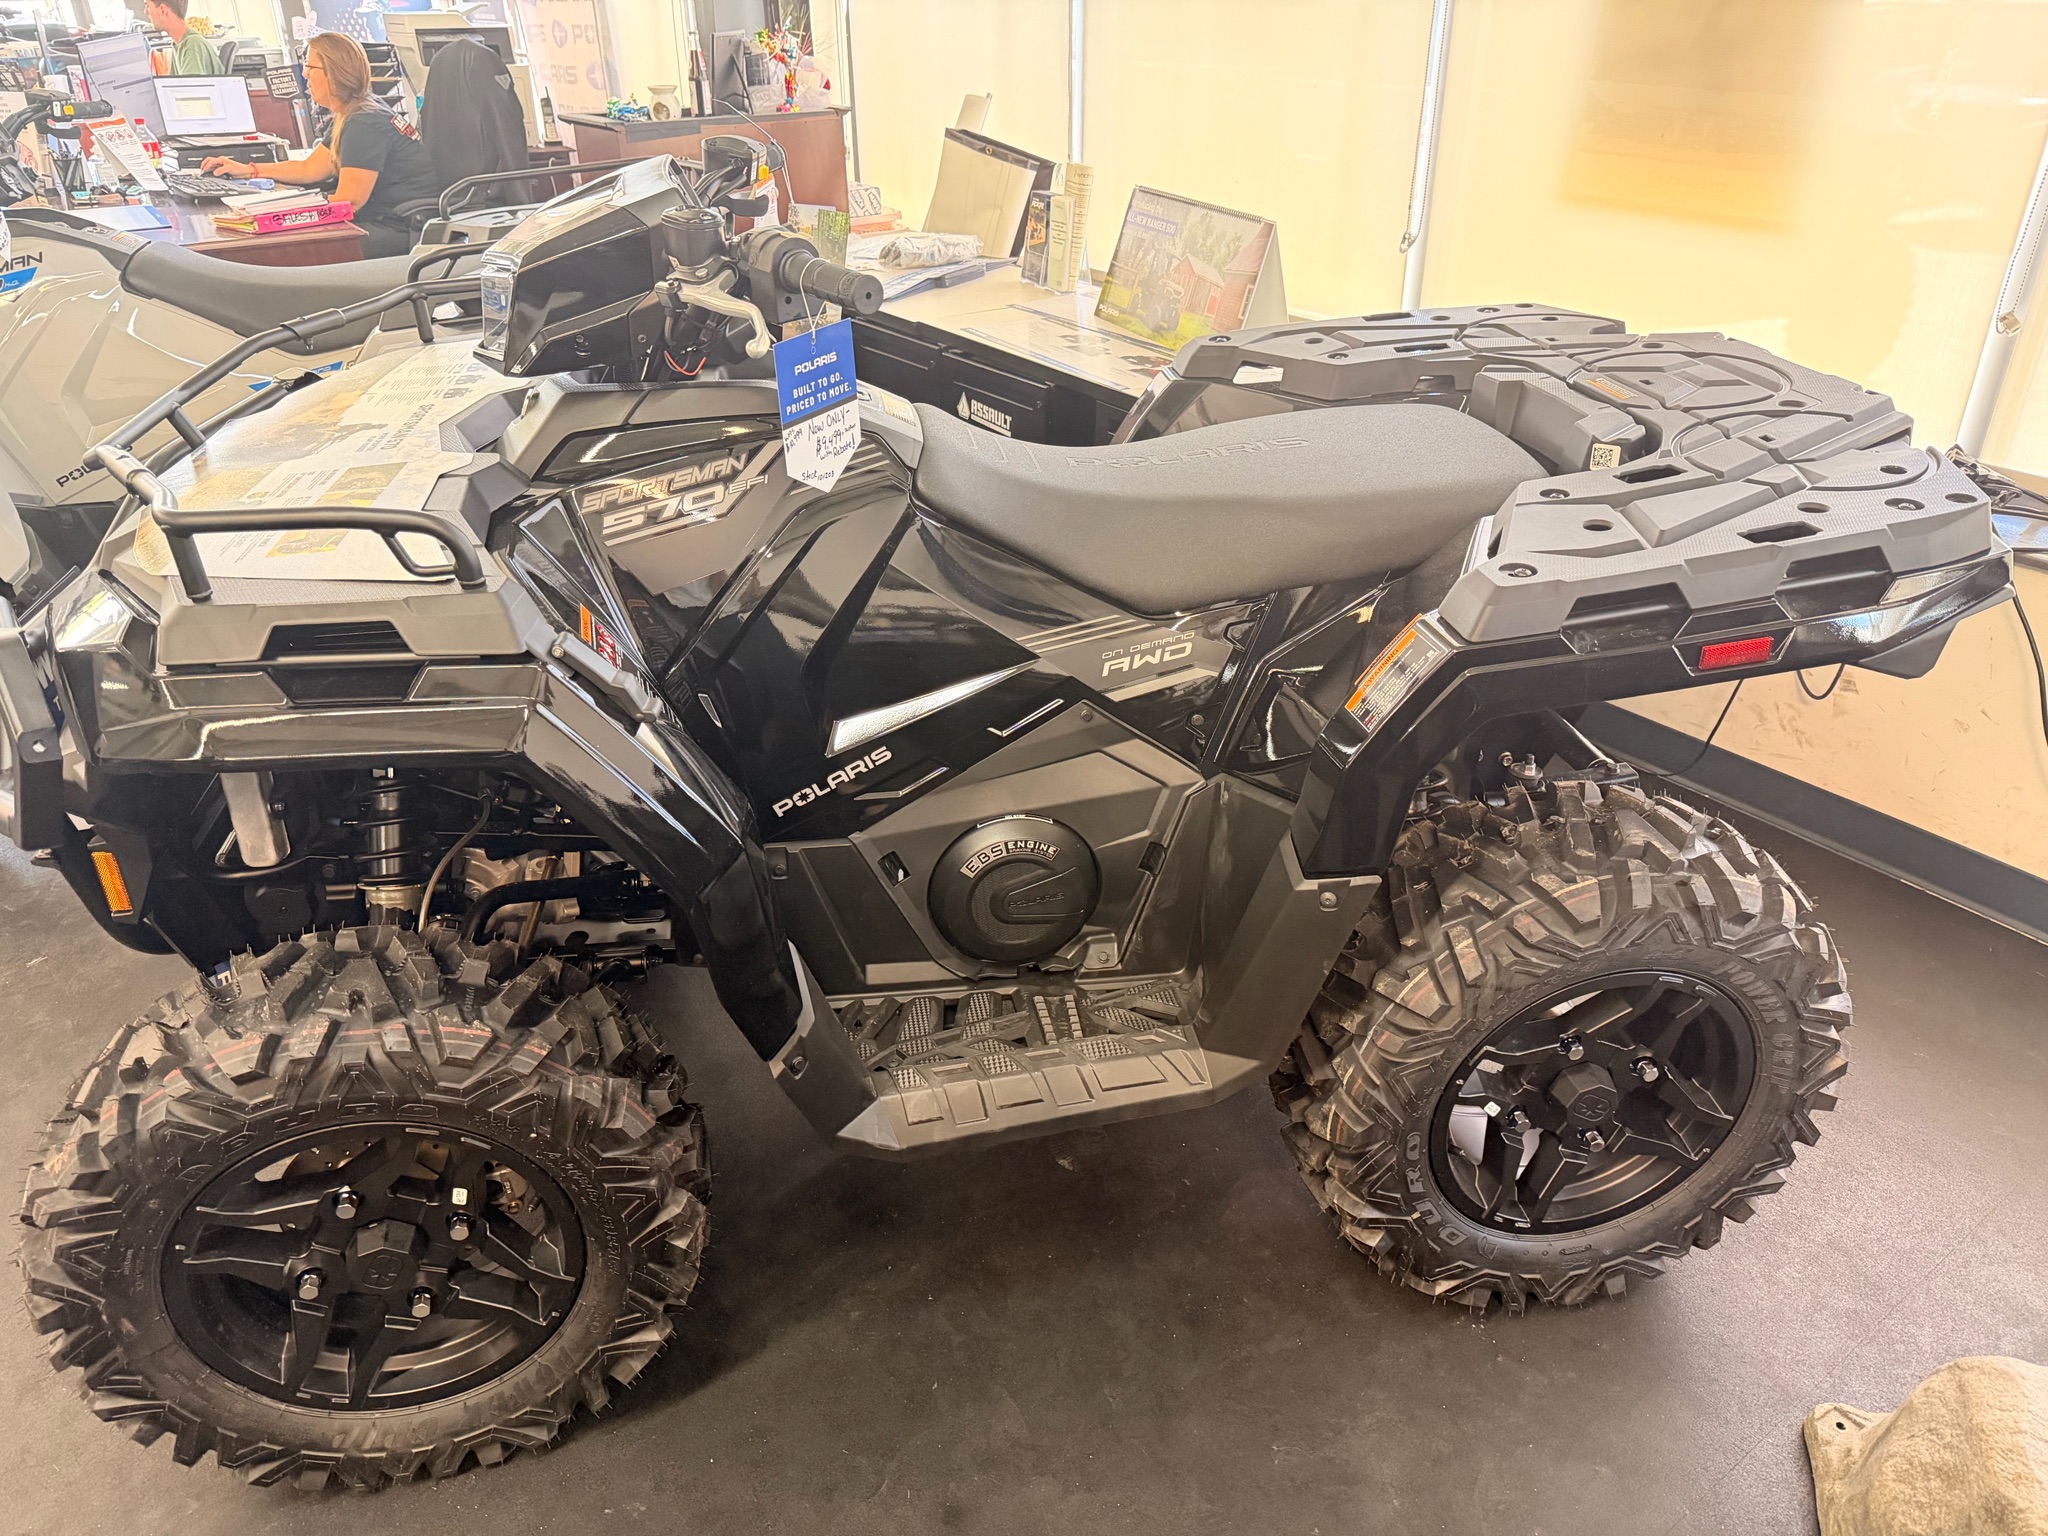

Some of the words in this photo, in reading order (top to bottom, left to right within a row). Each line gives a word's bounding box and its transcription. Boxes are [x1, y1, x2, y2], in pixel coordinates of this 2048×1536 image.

[1098, 303, 1120, 317] POLARIS
[794, 351, 838, 376] POLARIS
[786, 393, 816, 416] PRICED
[817, 390, 828, 402] TO
[829, 382, 852, 399] MOVE.
[792, 382, 816, 399] BUILT
[817, 377, 828, 389] TO
[830, 371, 843, 385] GO.
[970, 399, 1013, 431] ASSAULT
[1066, 436, 1310, 468] POLARIS
[581, 452, 749, 514] SPORTSMAN
[602, 481, 727, 535] 570
[728, 474, 770, 496] EFI
[1101, 648, 1124, 660] ON
[1130, 631, 1196, 653] DEMAND
[1101, 641, 1193, 677] AWD
[1367, 648, 1400, 684] WARNING
[772, 745, 893, 818] POLARIS
[965, 843, 1004, 874] EBS
[1007, 840, 1057, 855] ENGINE
[1710, 961, 1788, 1025] POWER
[1770, 1033, 1795, 1095] GRIP
[1405, 1131, 1470, 1248] DURO
